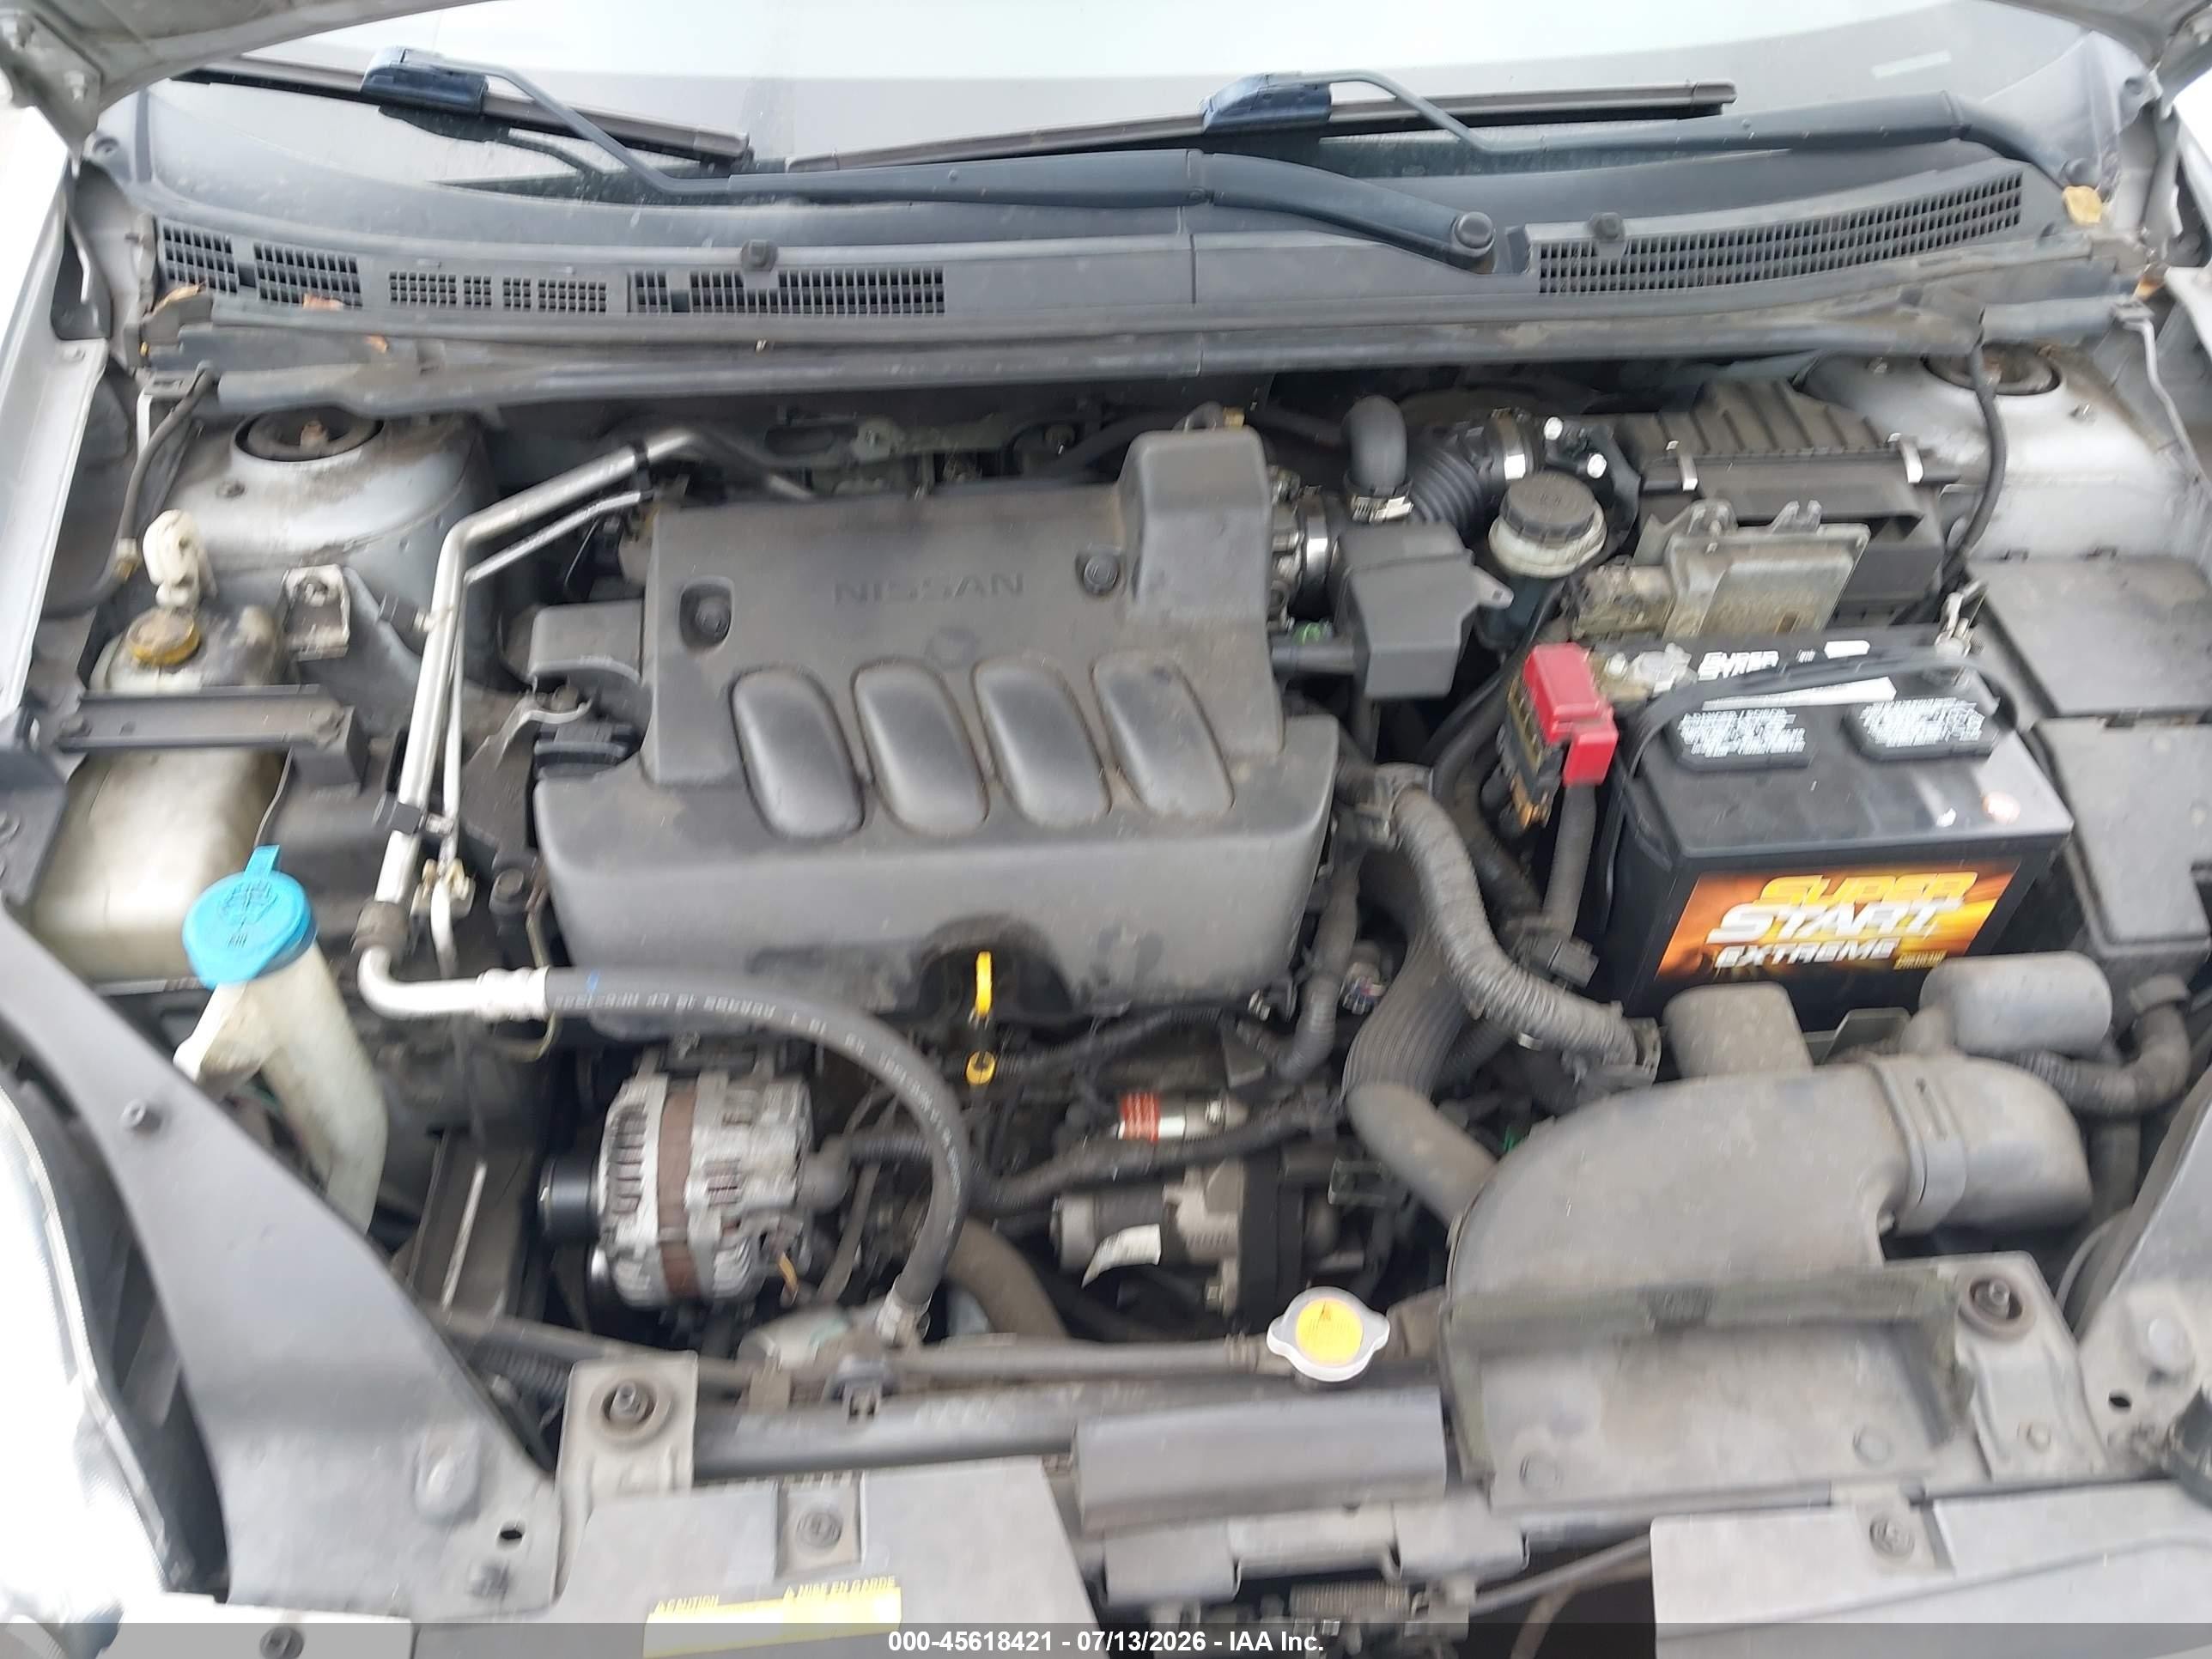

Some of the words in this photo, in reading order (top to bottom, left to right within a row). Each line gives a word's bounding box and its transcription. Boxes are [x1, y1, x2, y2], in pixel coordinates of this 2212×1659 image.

[834, 573, 1024, 603] NISSAN
[1752, 872, 1978, 906] SUPER
[1706, 898, 1963, 944] START
[1715, 937, 1902, 969] EXTREME
[830, 1578, 849, 1595] EN
[850, 1575, 896, 1595] GARDE
[665, 1594, 720, 1613] CAUTION
